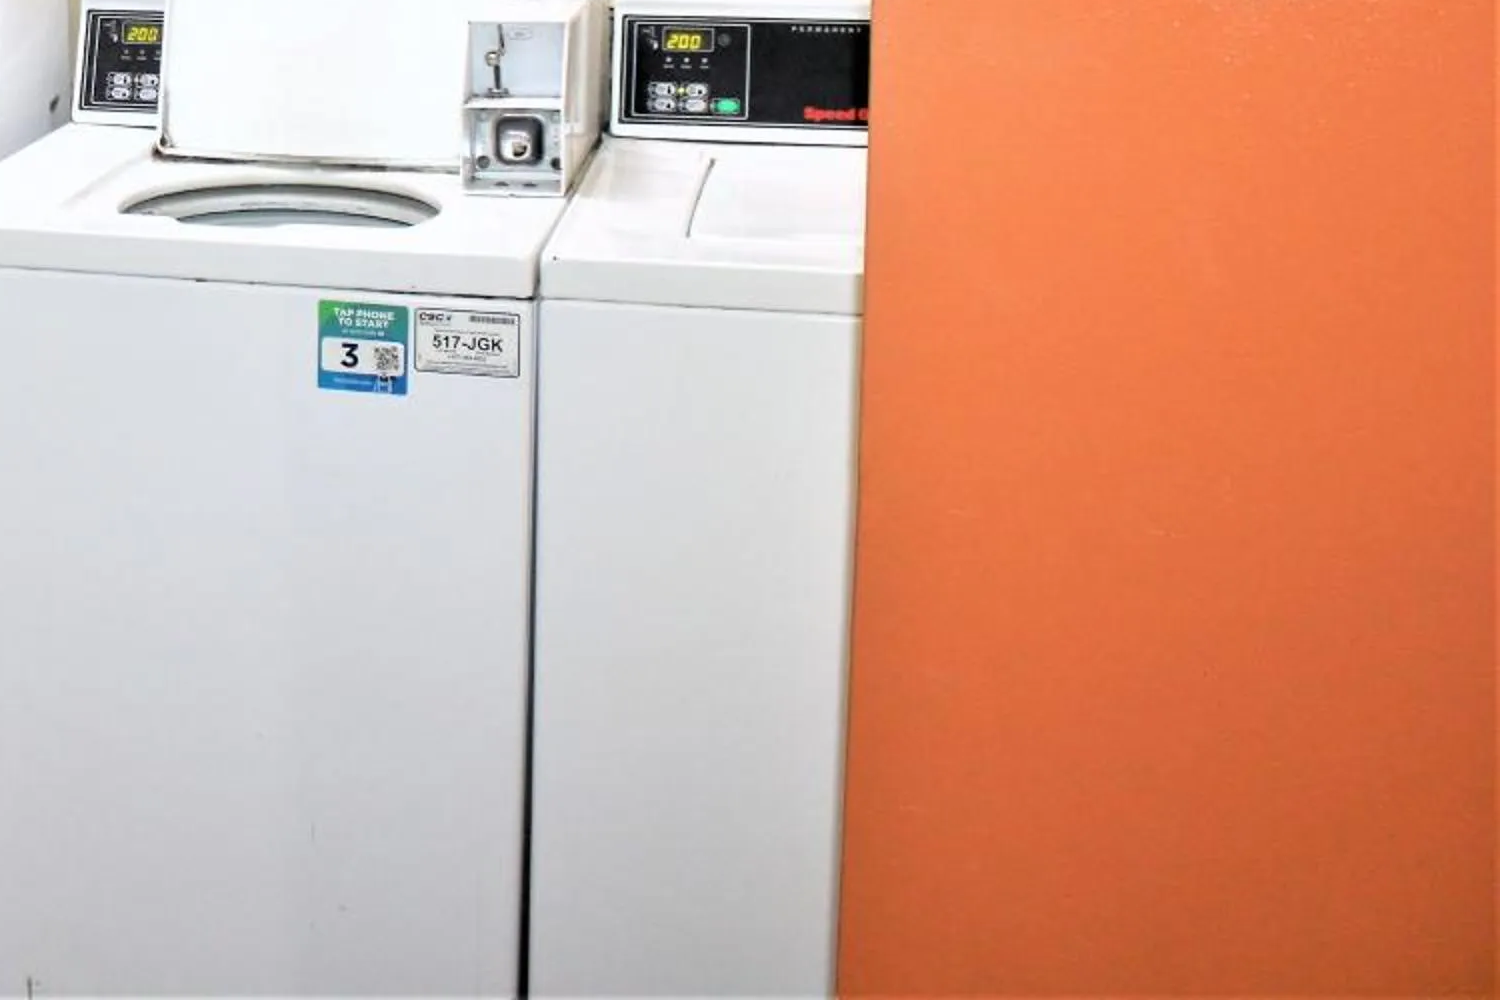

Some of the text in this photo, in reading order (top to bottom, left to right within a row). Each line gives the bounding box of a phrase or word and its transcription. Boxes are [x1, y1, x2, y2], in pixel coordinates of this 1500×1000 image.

[127, 27, 159, 41] 200
[666, 34, 701, 50] 200
[432, 334, 504, 353] 517-JGK
[340, 343, 360, 369] 3
